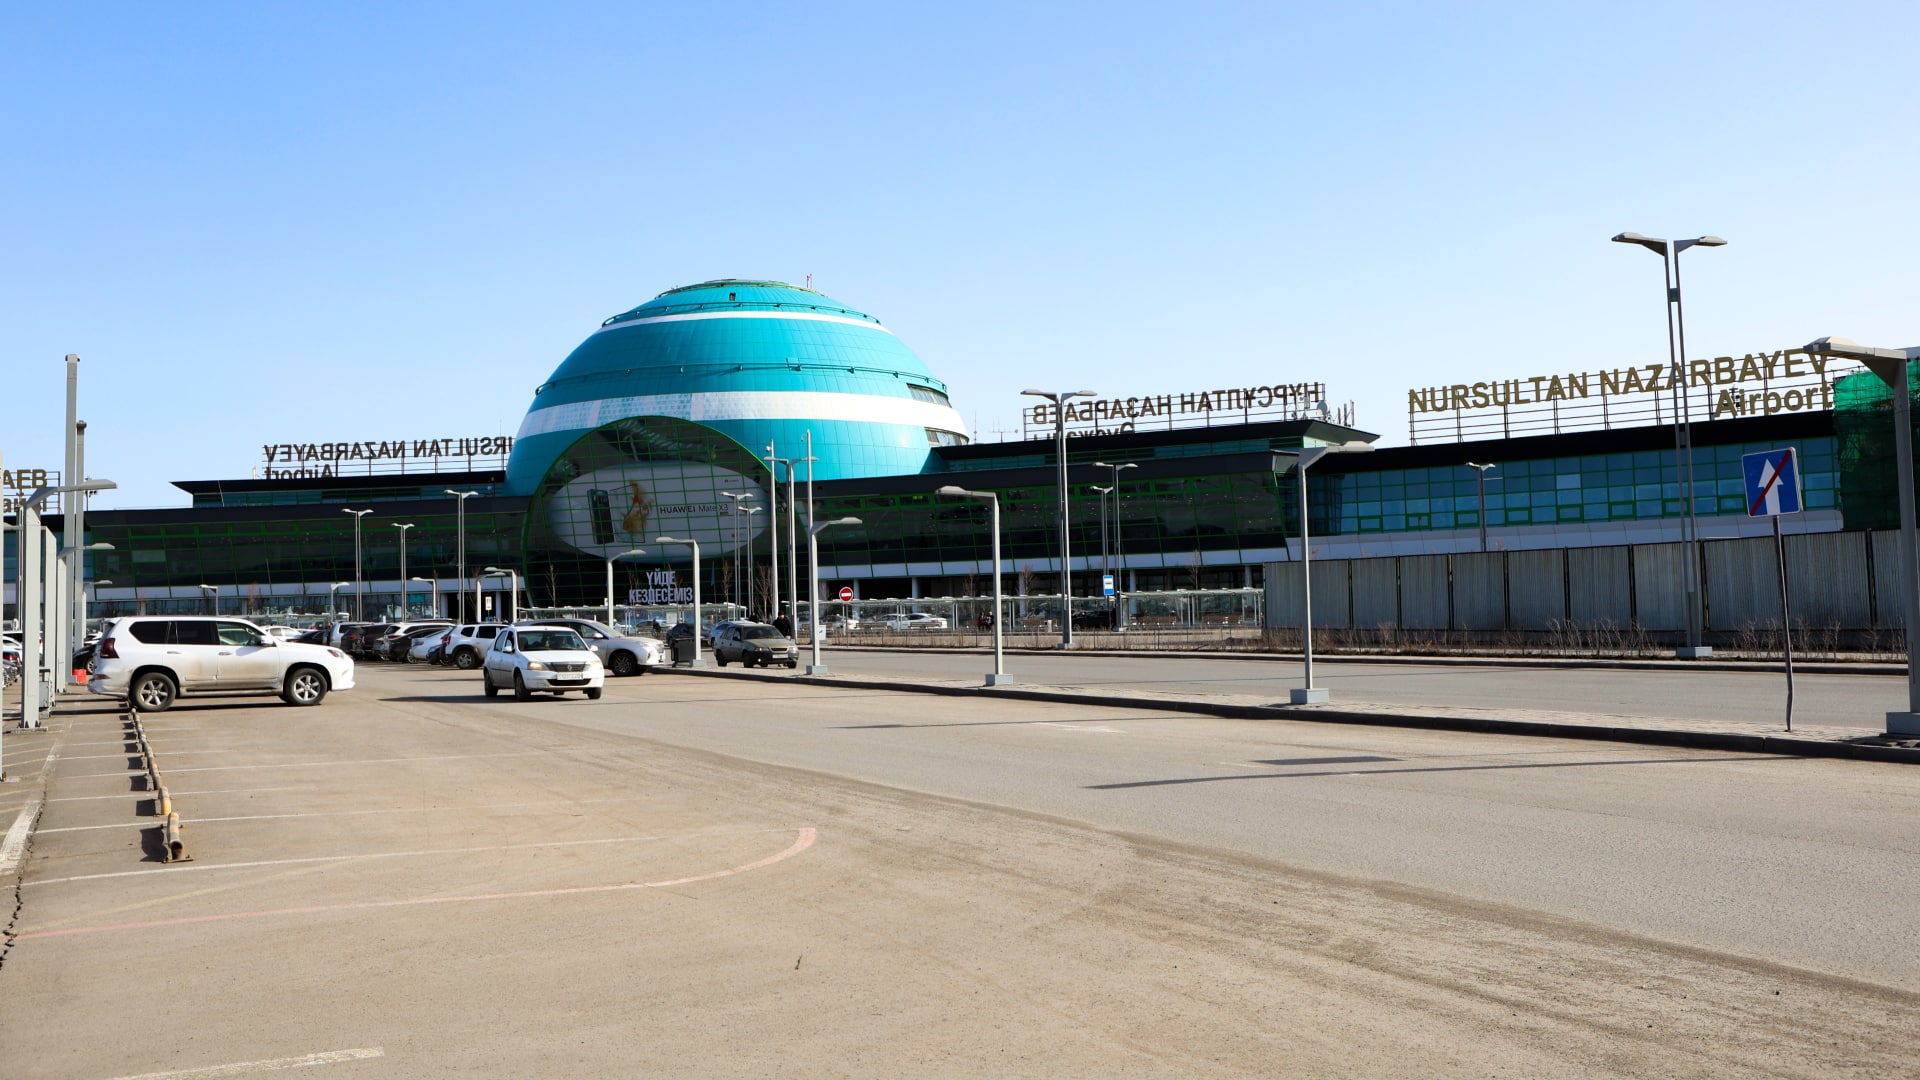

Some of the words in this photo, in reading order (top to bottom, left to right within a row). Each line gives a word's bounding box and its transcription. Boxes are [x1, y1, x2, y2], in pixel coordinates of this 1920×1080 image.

[1409, 372, 1588, 413] NURSULTAN
[1599, 347, 1829, 397] NAZARBAYEV
[1714, 380, 1833, 417] Airport
[659, 505, 696, 514] HUAWEI
[628, 587, 693, 604] КЕЗДЕСЕМІЗ
